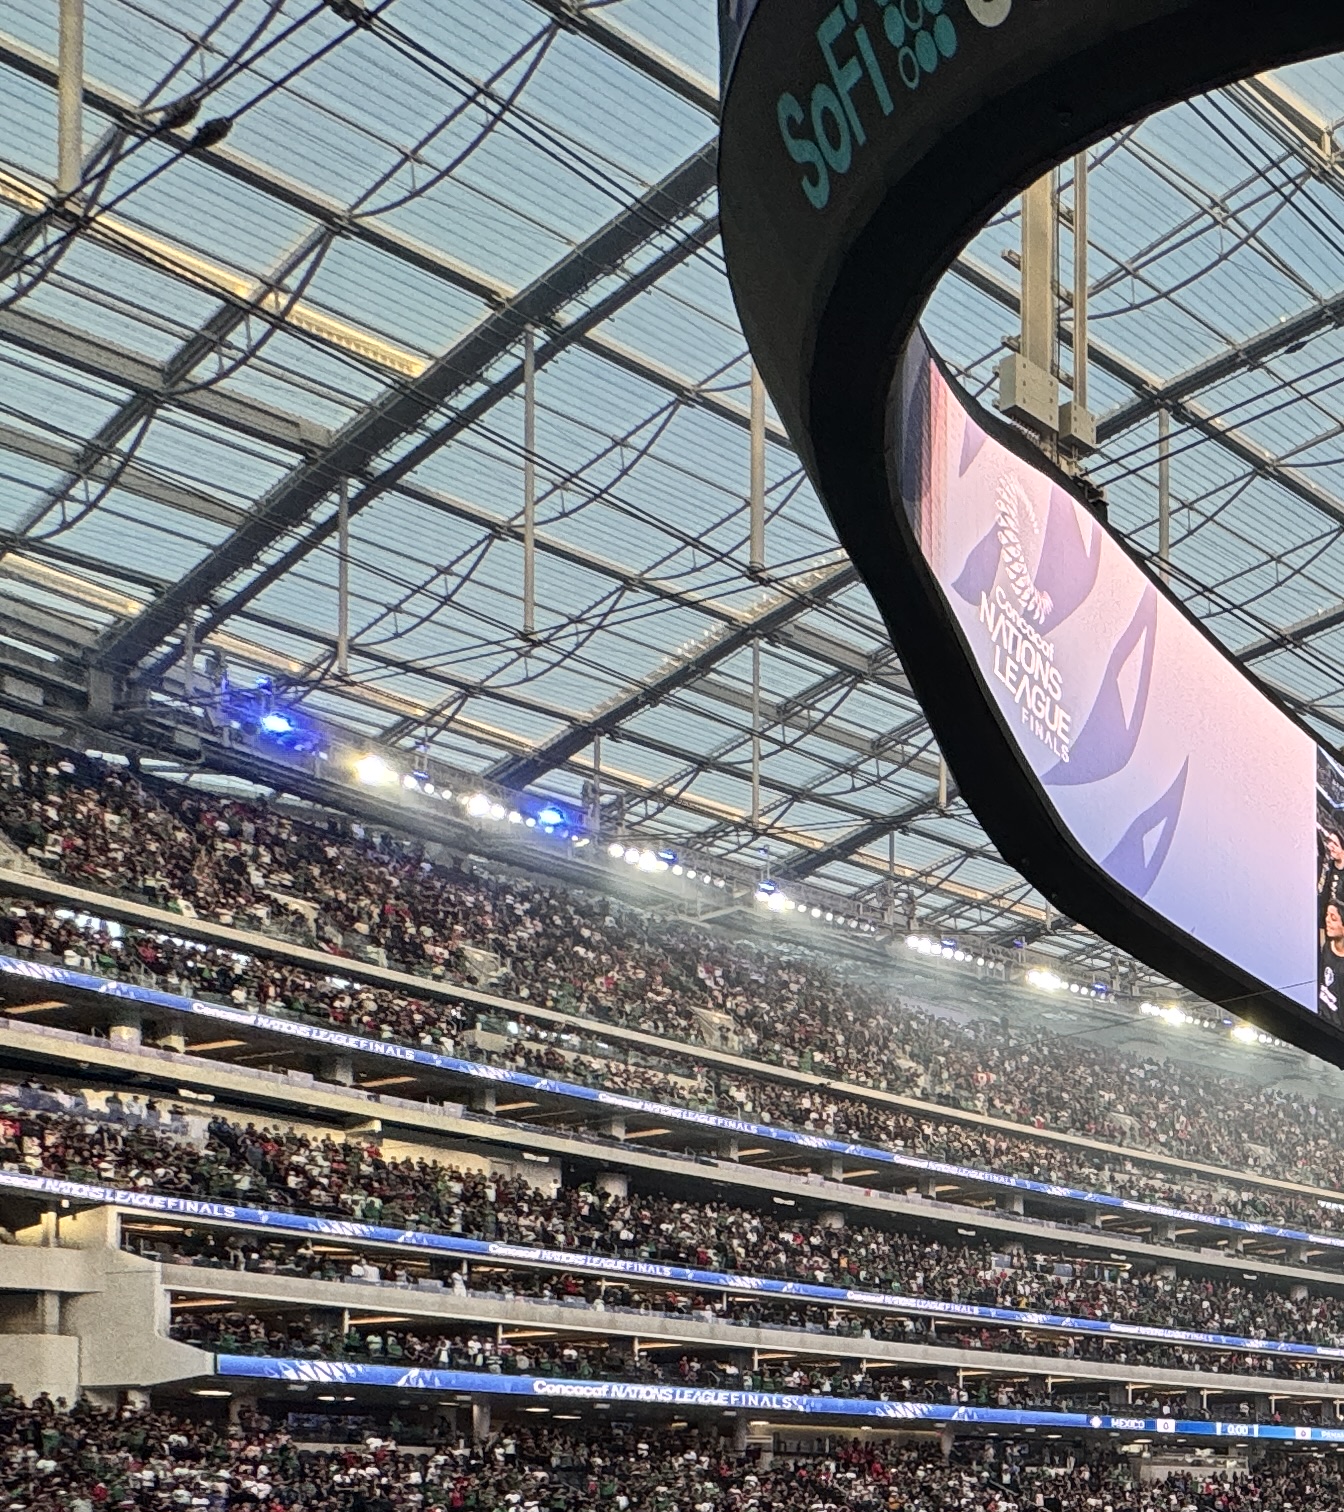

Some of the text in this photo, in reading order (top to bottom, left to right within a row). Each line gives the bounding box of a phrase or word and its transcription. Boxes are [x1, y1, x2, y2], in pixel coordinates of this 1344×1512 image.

[777, 0, 893, 209] SoFi
[995, 585, 1055, 662] Concacaf
[979, 590, 1063, 701] NATIONS
[994, 645, 1071, 744] LEAGUE
[1022, 706, 1070, 763] FINALS
[360, 1039, 414, 1061] FINALS
[166, 1197, 235, 1219] FINALS
[625, 1260, 672, 1277] FINALS
[534, 1380, 790, 1409] Concacaf NATIONS LEAGUE FINALS
[1110, 1418, 1146, 1430] MEXICO
